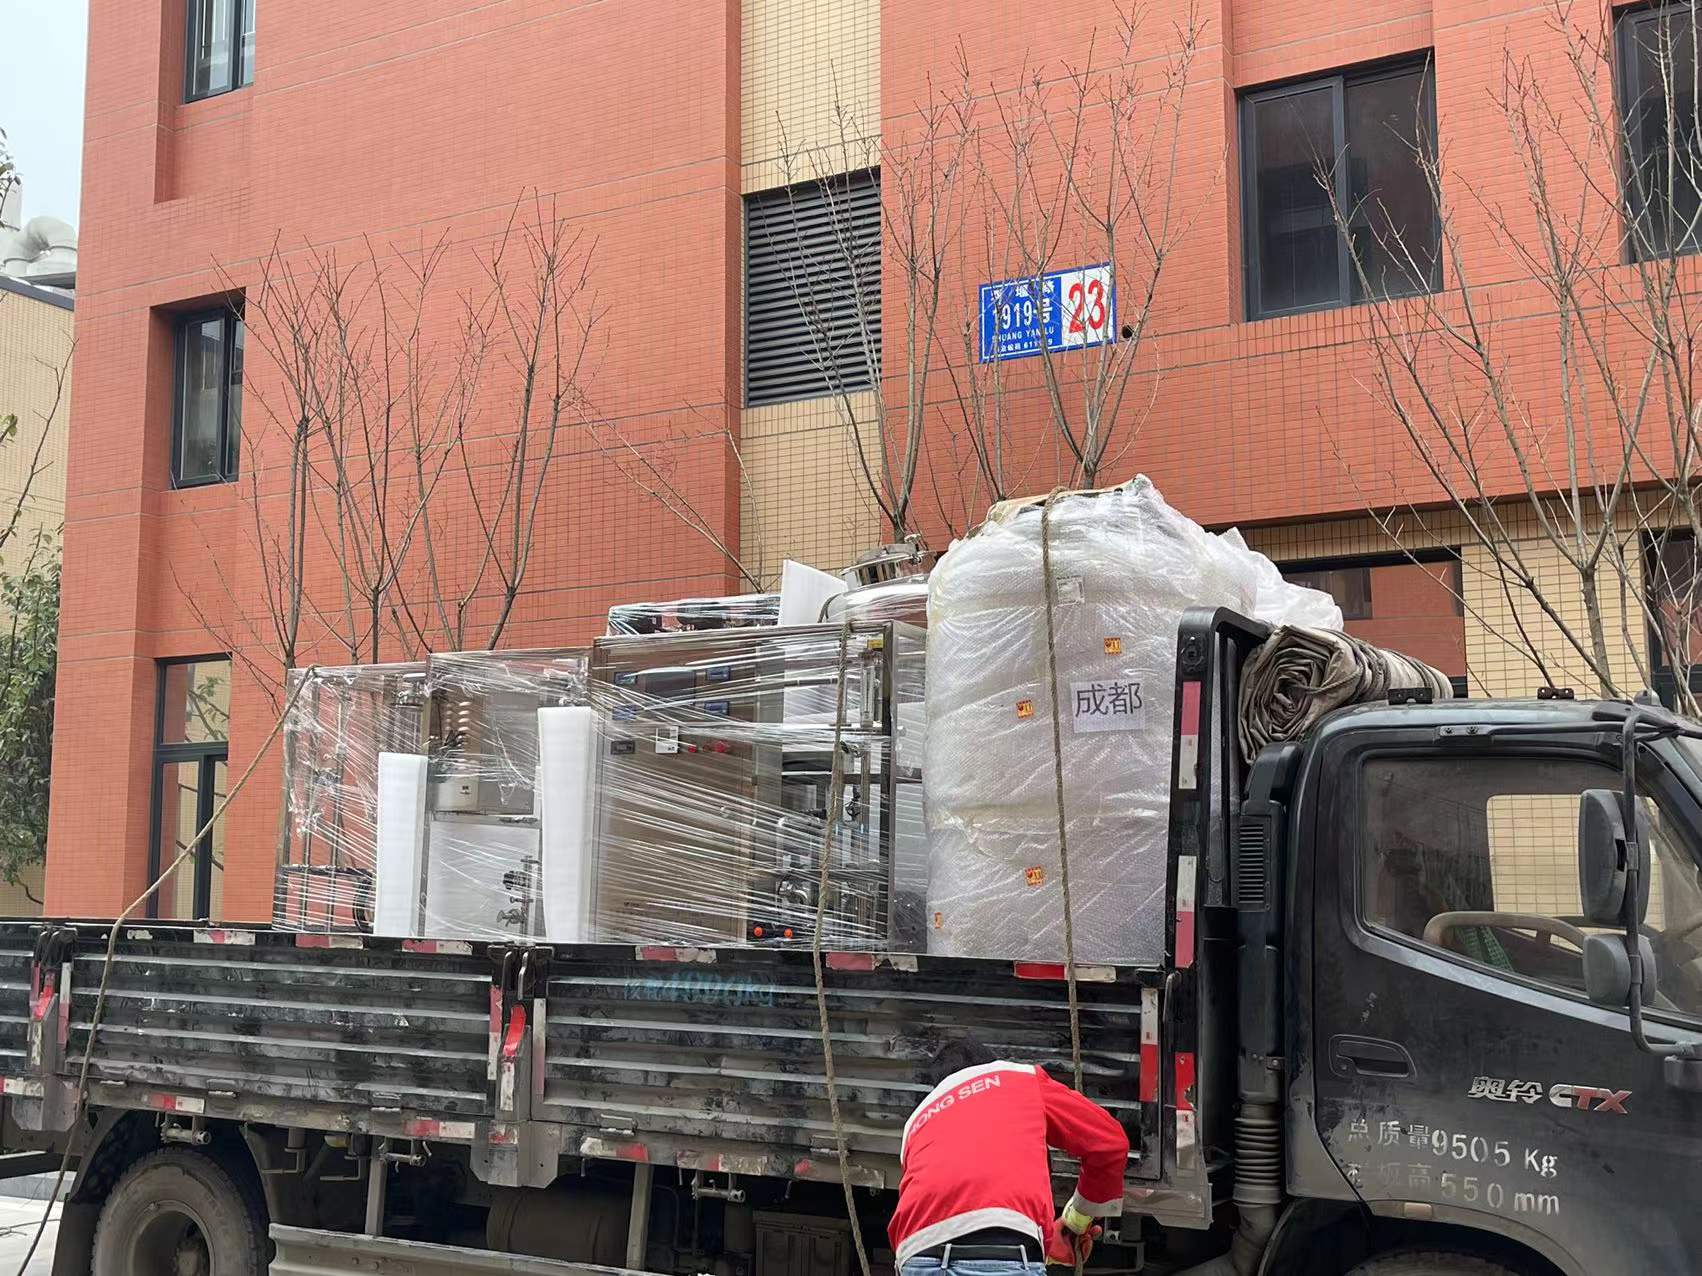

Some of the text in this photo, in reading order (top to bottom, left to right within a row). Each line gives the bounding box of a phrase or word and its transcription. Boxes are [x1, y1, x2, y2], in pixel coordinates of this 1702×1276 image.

[1068, 278, 1106, 334] 23
[1075, 682, 1142, 718] 成都
[958, 1075, 1001, 1100] SEN
[1468, 1075, 1633, 1115] 奥铃 CTX
[1524, 1147, 1558, 1178] Kg
[1512, 1191, 1561, 1216] mm
